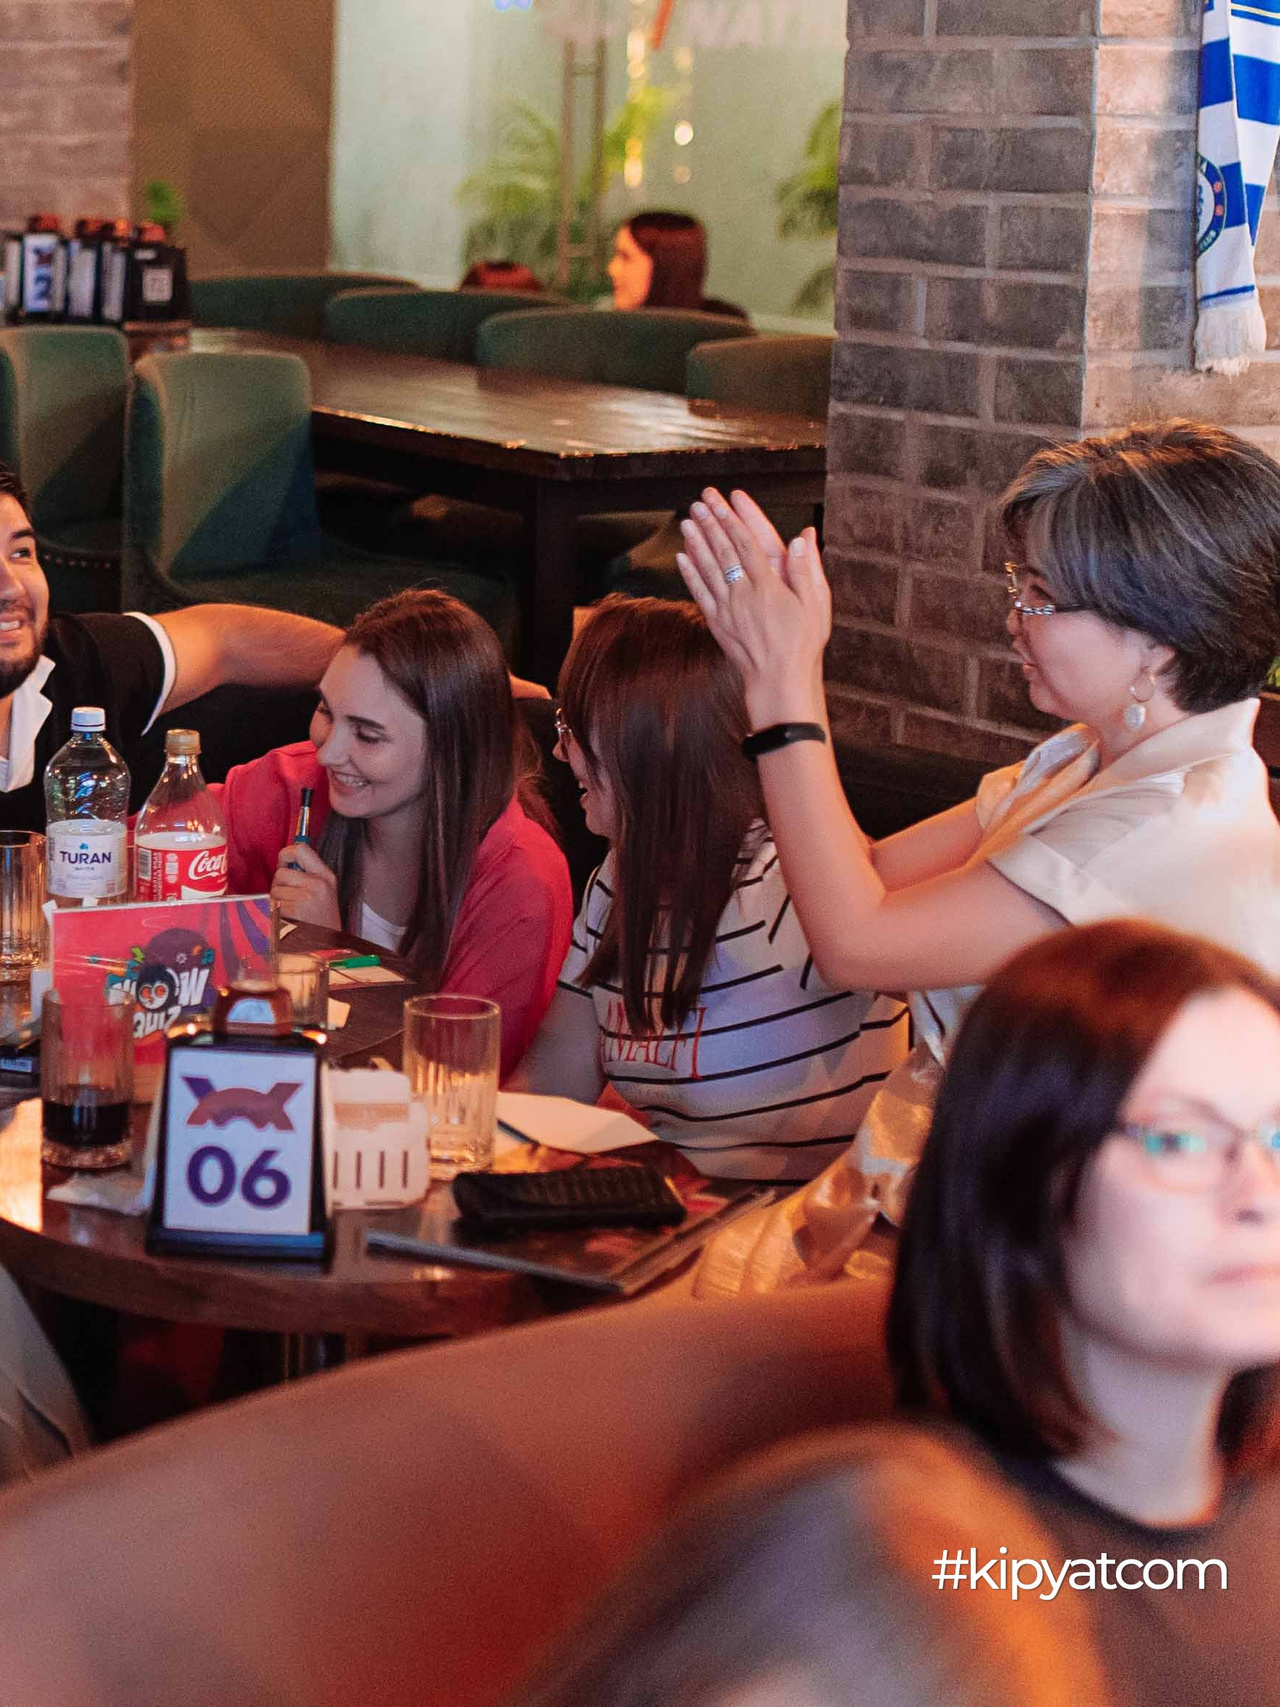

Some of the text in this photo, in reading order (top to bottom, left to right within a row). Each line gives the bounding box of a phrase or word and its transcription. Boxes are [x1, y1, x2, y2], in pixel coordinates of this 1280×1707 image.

[59, 850, 112, 864] TURAN
[132, 1005, 183, 1040] QUIZ
[186, 1144, 292, 1209] 06
